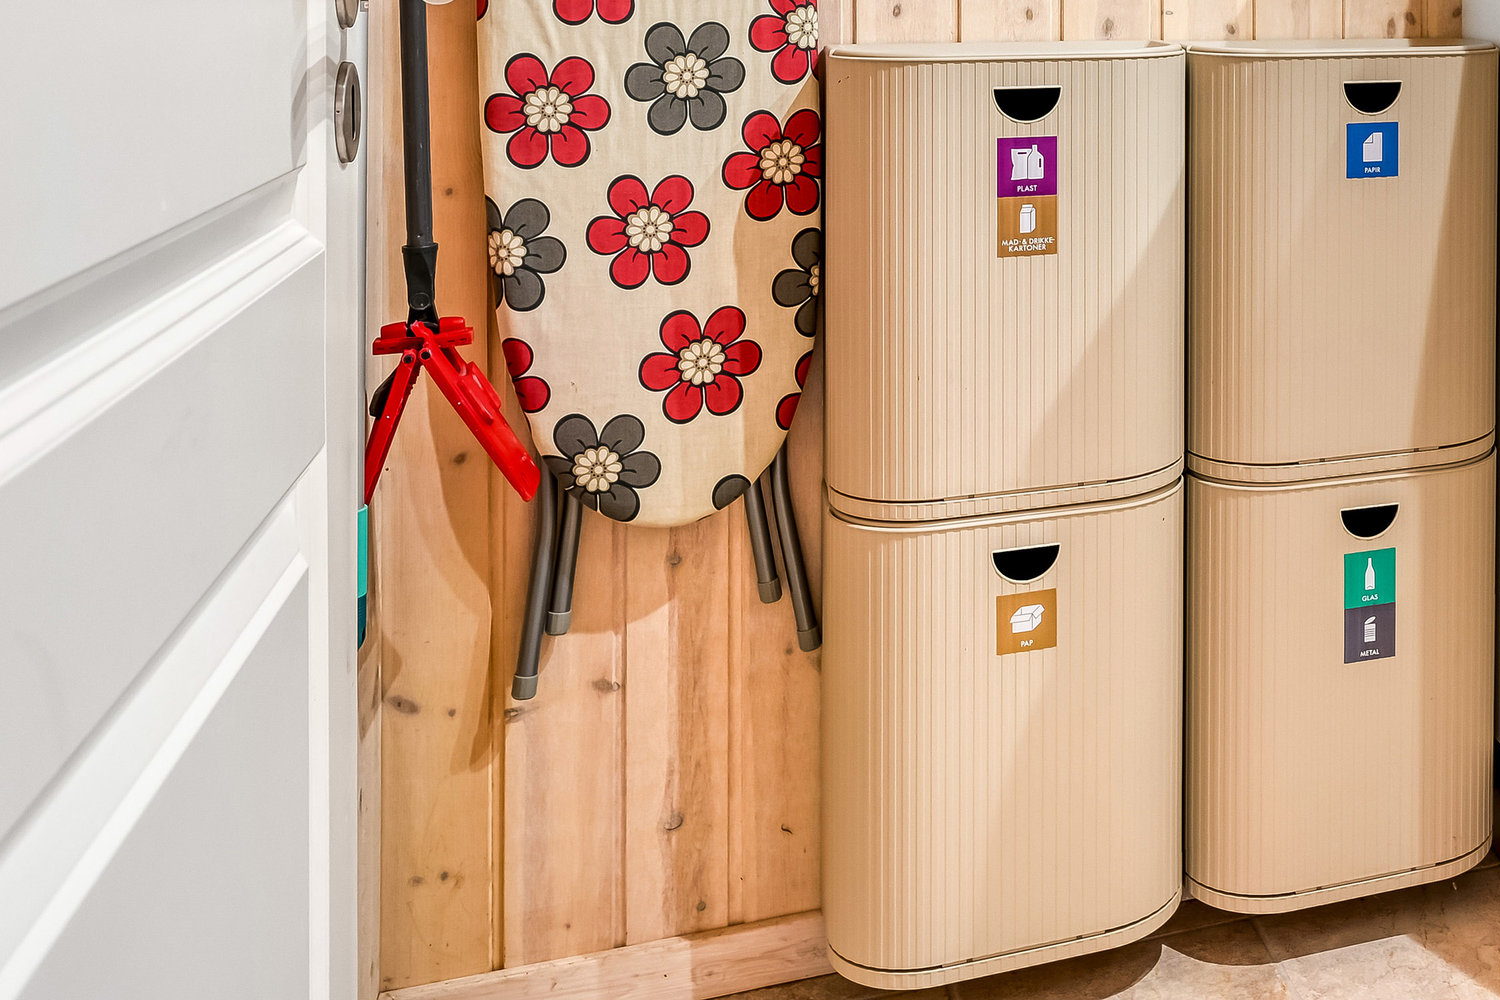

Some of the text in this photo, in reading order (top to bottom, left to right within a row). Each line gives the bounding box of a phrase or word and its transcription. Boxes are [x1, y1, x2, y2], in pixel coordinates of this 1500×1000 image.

[1016, 184, 1038, 193] PLAST
[1008, 243, 1047, 253] KARTONER
[1361, 593, 1379, 602] GLAS
[1020, 639, 1034, 648] PAP
[1360, 649, 1380, 657] METAL
